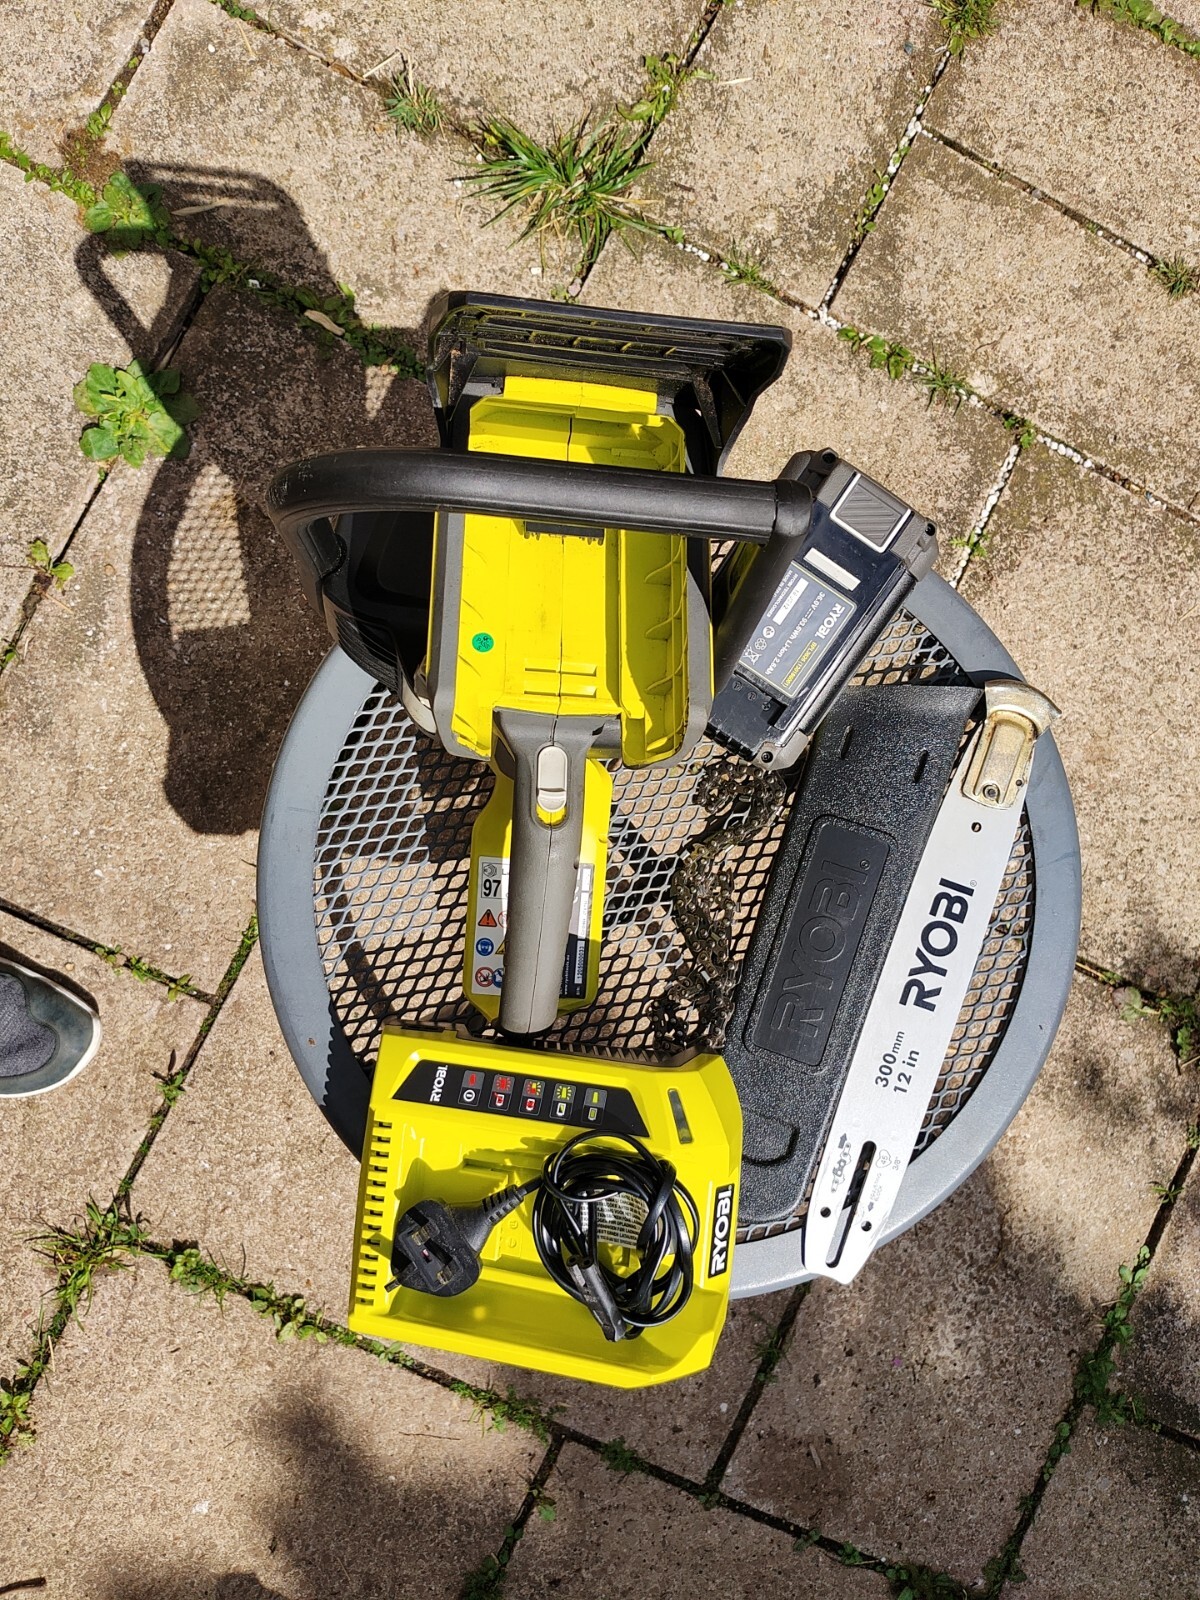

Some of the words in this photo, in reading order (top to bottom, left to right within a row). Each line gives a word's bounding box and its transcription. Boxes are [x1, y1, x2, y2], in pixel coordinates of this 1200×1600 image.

[814, 603, 845, 639] RYOBI
[483, 879, 501, 897] 97
[771, 858, 870, 1037] RYOBI
[900, 878, 975, 1012] RYOBI
[875, 1030, 905, 1088] 300mm
[902, 1049, 920, 1070] in
[430, 1065, 448, 1103] RYOBI
[893, 1072, 913, 1094] 12
[712, 1191, 732, 1273] RYOBI
